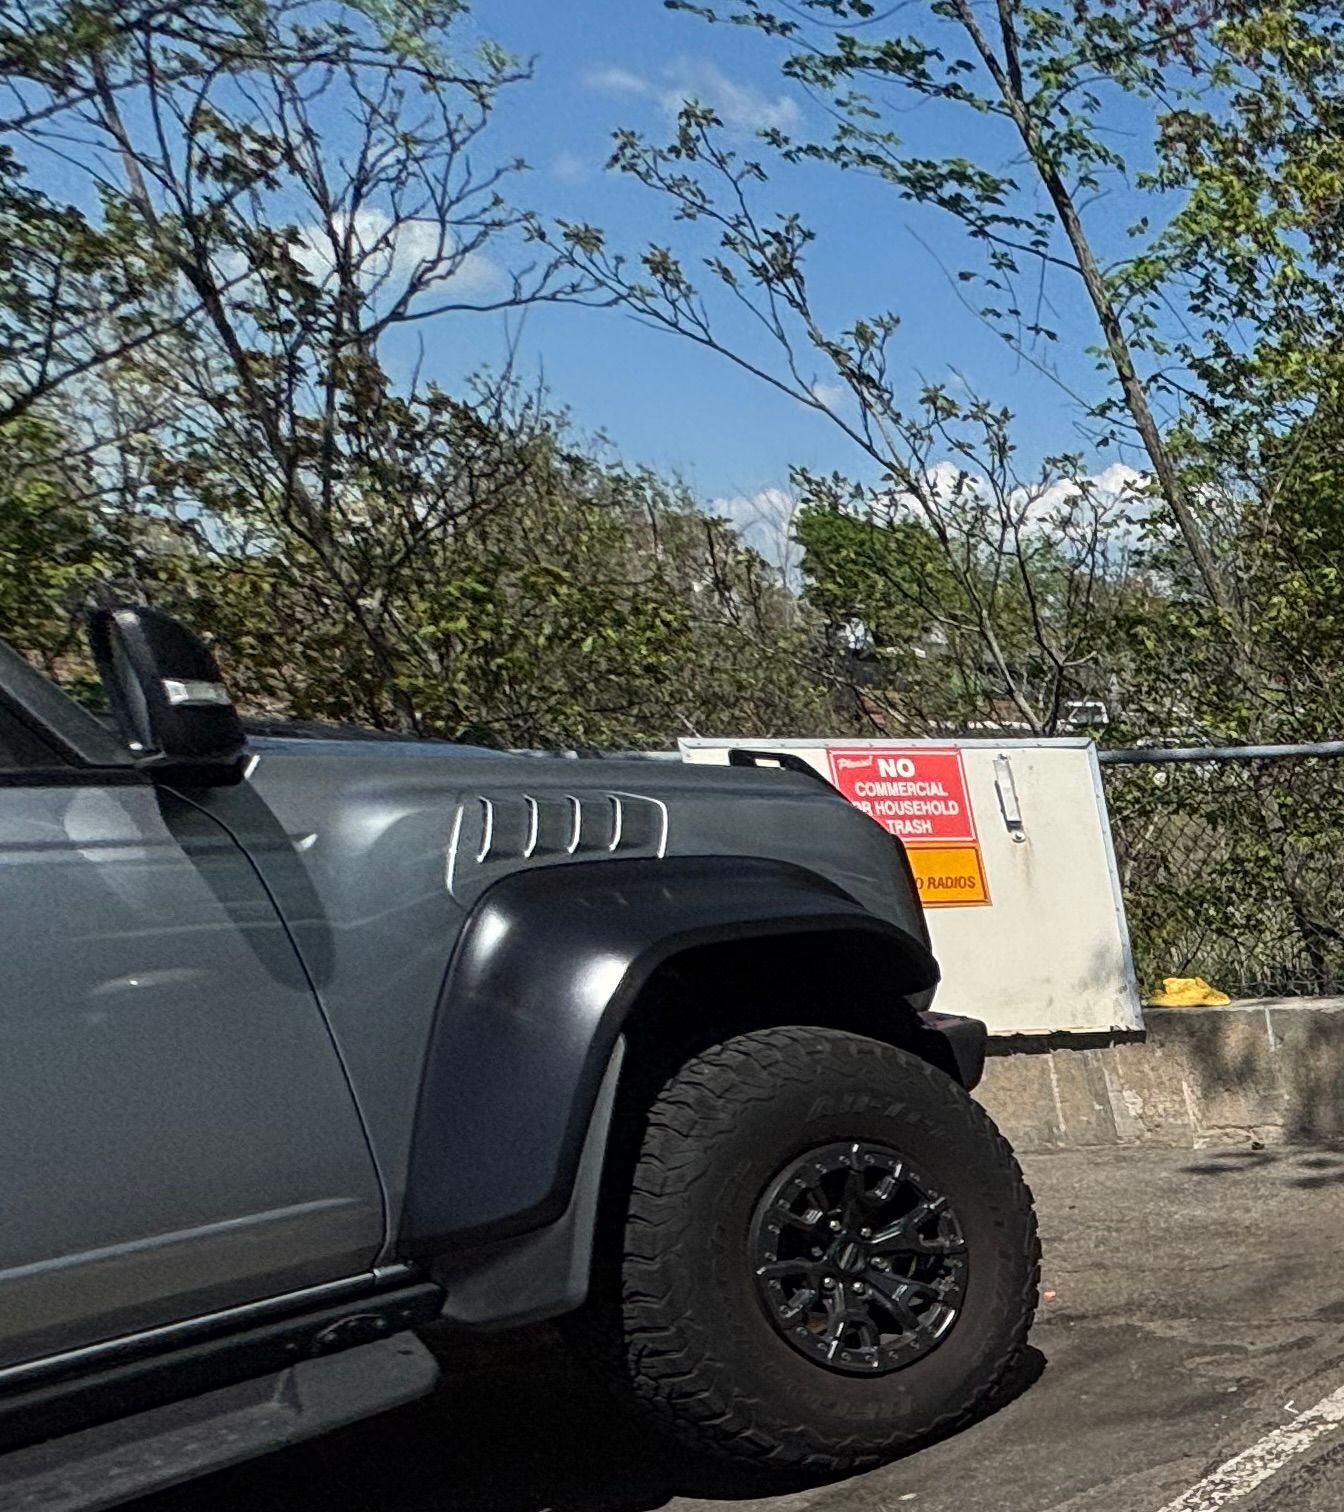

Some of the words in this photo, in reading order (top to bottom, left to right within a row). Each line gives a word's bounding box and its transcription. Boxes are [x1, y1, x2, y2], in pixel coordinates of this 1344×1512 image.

[877, 758, 916, 778] NO
[855, 781, 949, 797] COMMERCIAL
[874, 801, 960, 815] HOUSEHOLD
[886, 820, 933, 834] TRASH
[927, 876, 976, 889] RADIOS
